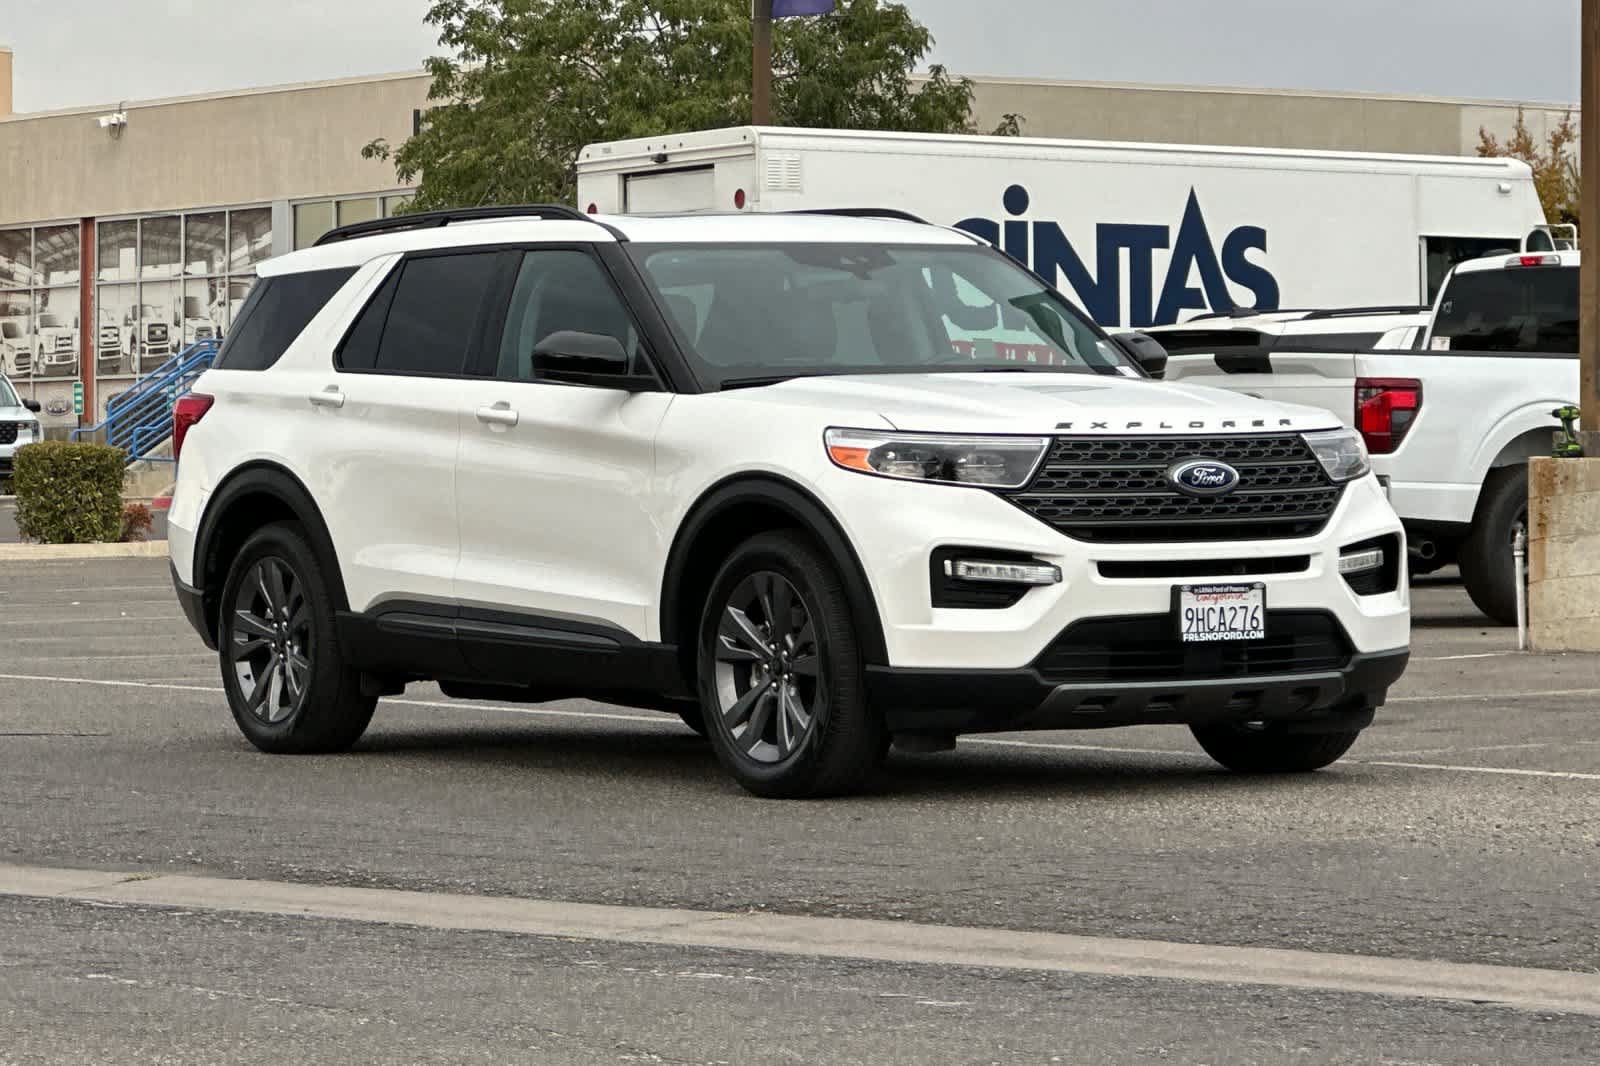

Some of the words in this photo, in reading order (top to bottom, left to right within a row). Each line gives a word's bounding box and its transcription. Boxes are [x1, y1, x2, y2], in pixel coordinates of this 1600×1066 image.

[1055, 418, 1292, 430] EXPLORER
[1191, 466, 1226, 486] Ford
[1185, 605, 1260, 632] 9HCA276
[1183, 630, 1264, 641] FRESNOFORD.COM
